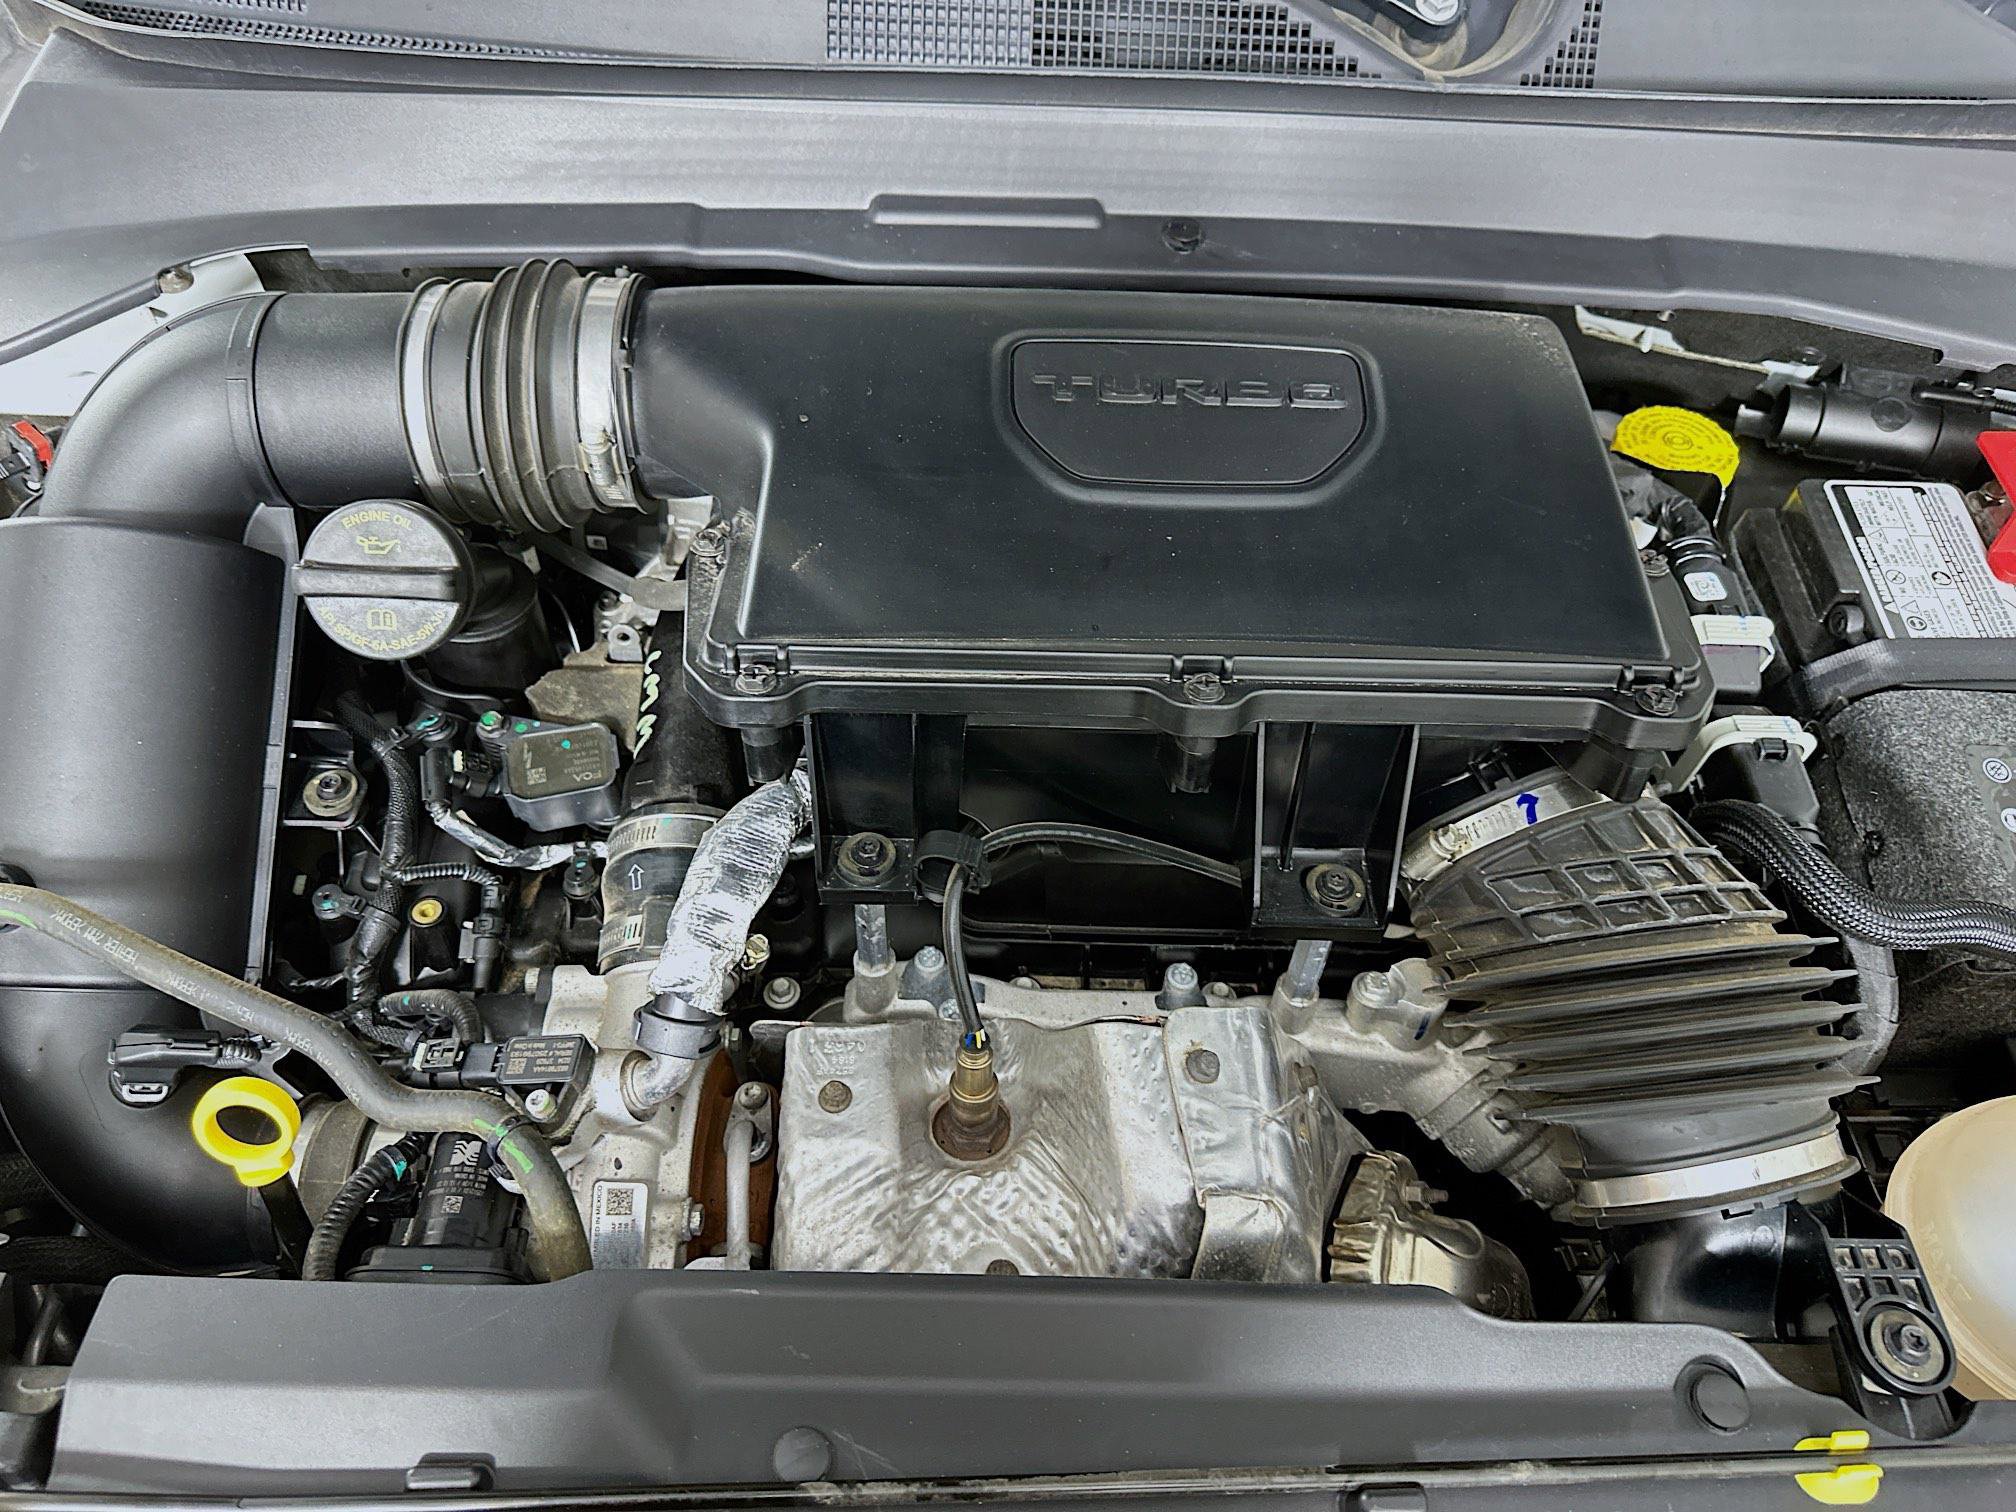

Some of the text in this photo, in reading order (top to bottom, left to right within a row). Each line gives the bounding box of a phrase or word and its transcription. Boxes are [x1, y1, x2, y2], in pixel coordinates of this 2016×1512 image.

[1032, 374, 1348, 409] TURBO
[340, 511, 413, 529] ENGINE OIL
[572, 770, 602, 782] FCA
[595, 1185, 603, 1215] MEXICO
